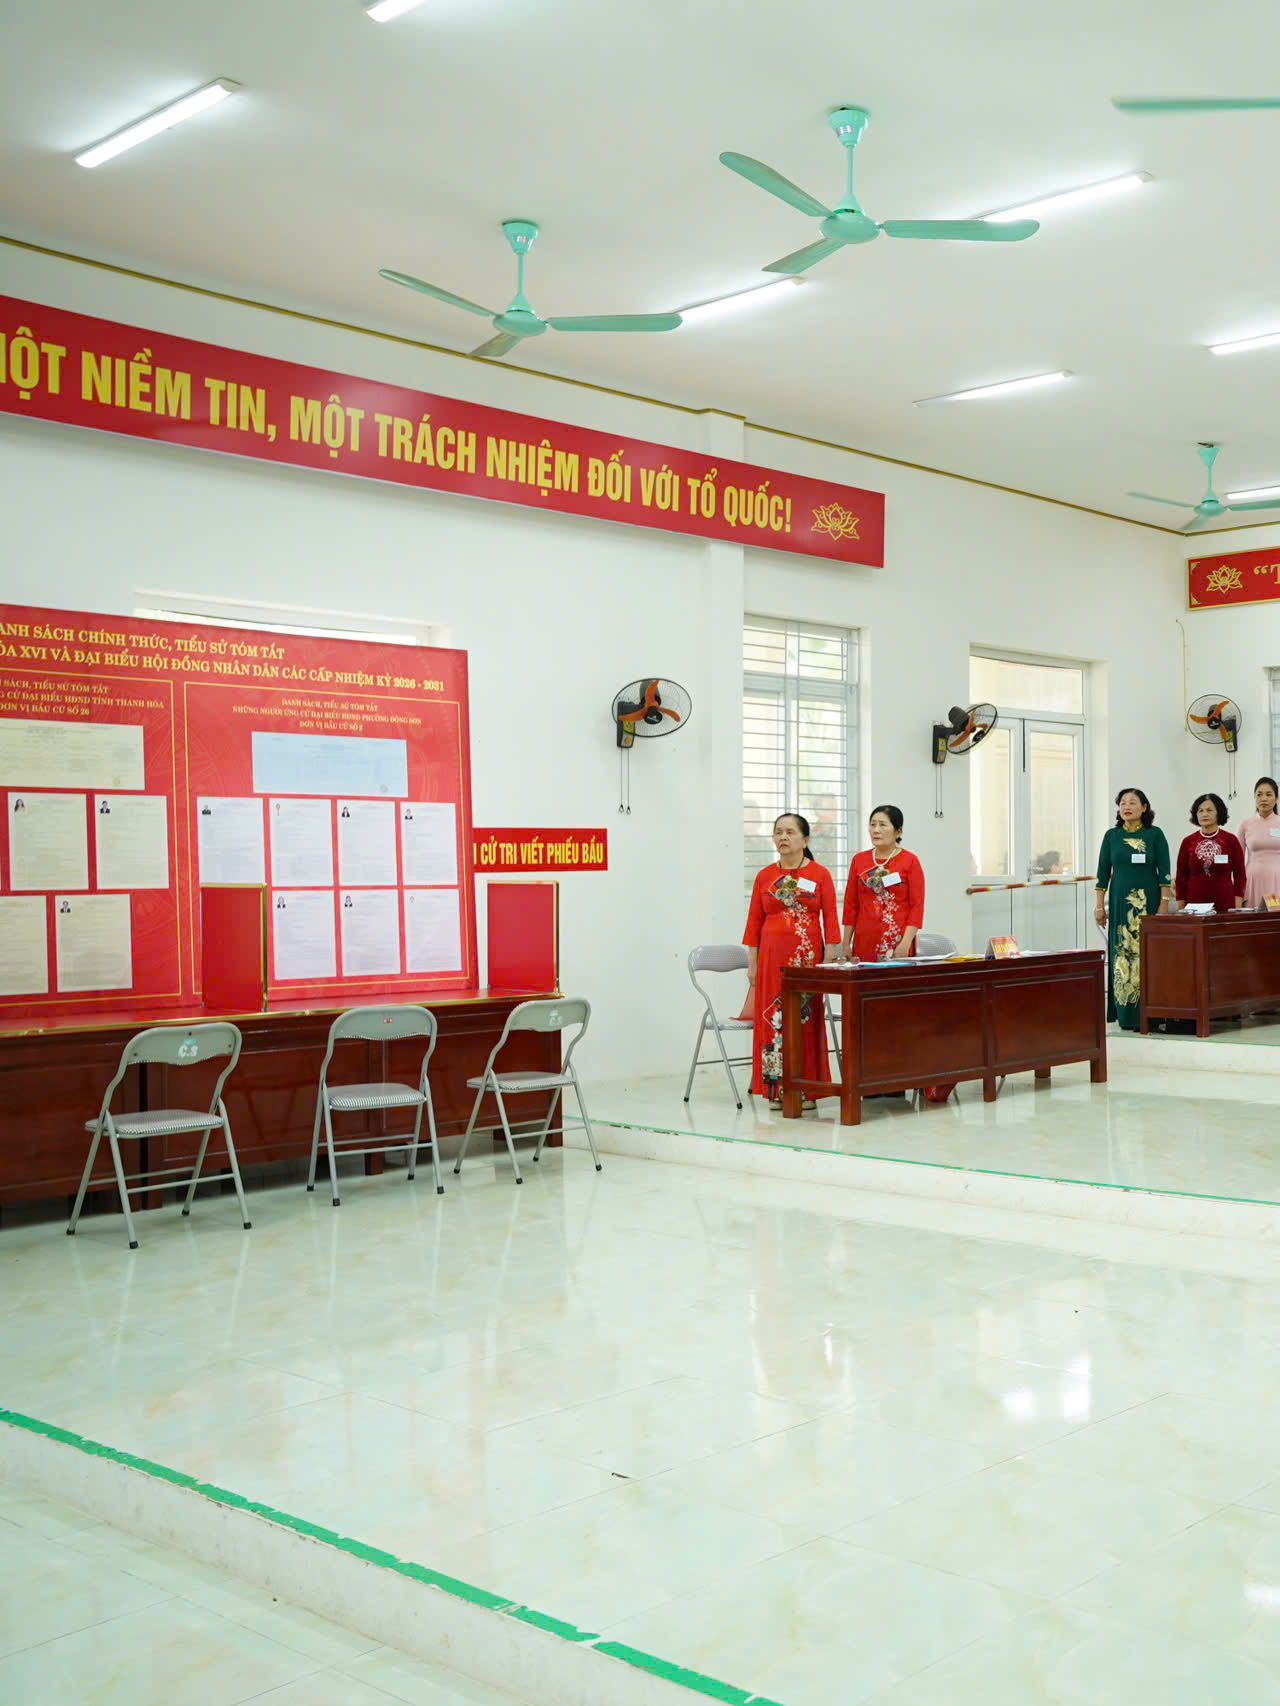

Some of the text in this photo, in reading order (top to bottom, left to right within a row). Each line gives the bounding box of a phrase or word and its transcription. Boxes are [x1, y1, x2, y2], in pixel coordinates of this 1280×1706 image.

[0, 326, 792, 533] ỘT NIỀM TIN, MỘT TRÁCH NHIỆM ĐỐI VỚI TỔ QUỐC!
[33, 623, 75, 641] SÁCH
[78, 629, 126, 646] CHÍNH
[129, 633, 172, 652] THỨC,
[175, 635, 207, 653] TIỂU
[209, 639, 228, 654] SỬ
[230, 641, 258, 657] TÓM
[260, 643, 285, 660] TẮT
[19, 645, 47, 660] XVI
[50, 646, 71, 662] VÀ
[74, 650, 100, 666] ĐẠI
[104, 648, 139, 668] BIỂU
[143, 654, 168, 672] HỘI
[171, 653, 210, 672] ĐỒNG
[213, 659, 250, 676] NHÂN
[253, 662, 279, 677] DÂN
[282, 665, 307, 680] CÁC
[309, 666, 333, 682] CẤP
[335, 671, 374, 687] NHIỆM
[393, 677, 416, 689] 2026
[423, 679, 445, 691] 2031
[71, 682, 90, 692] TÓM
[480, 835, 498, 865] CỬ
[499, 842, 518, 865] TRI
[520, 835, 544, 865] VIẾT
[547, 836, 579, 864] PHIẾU
